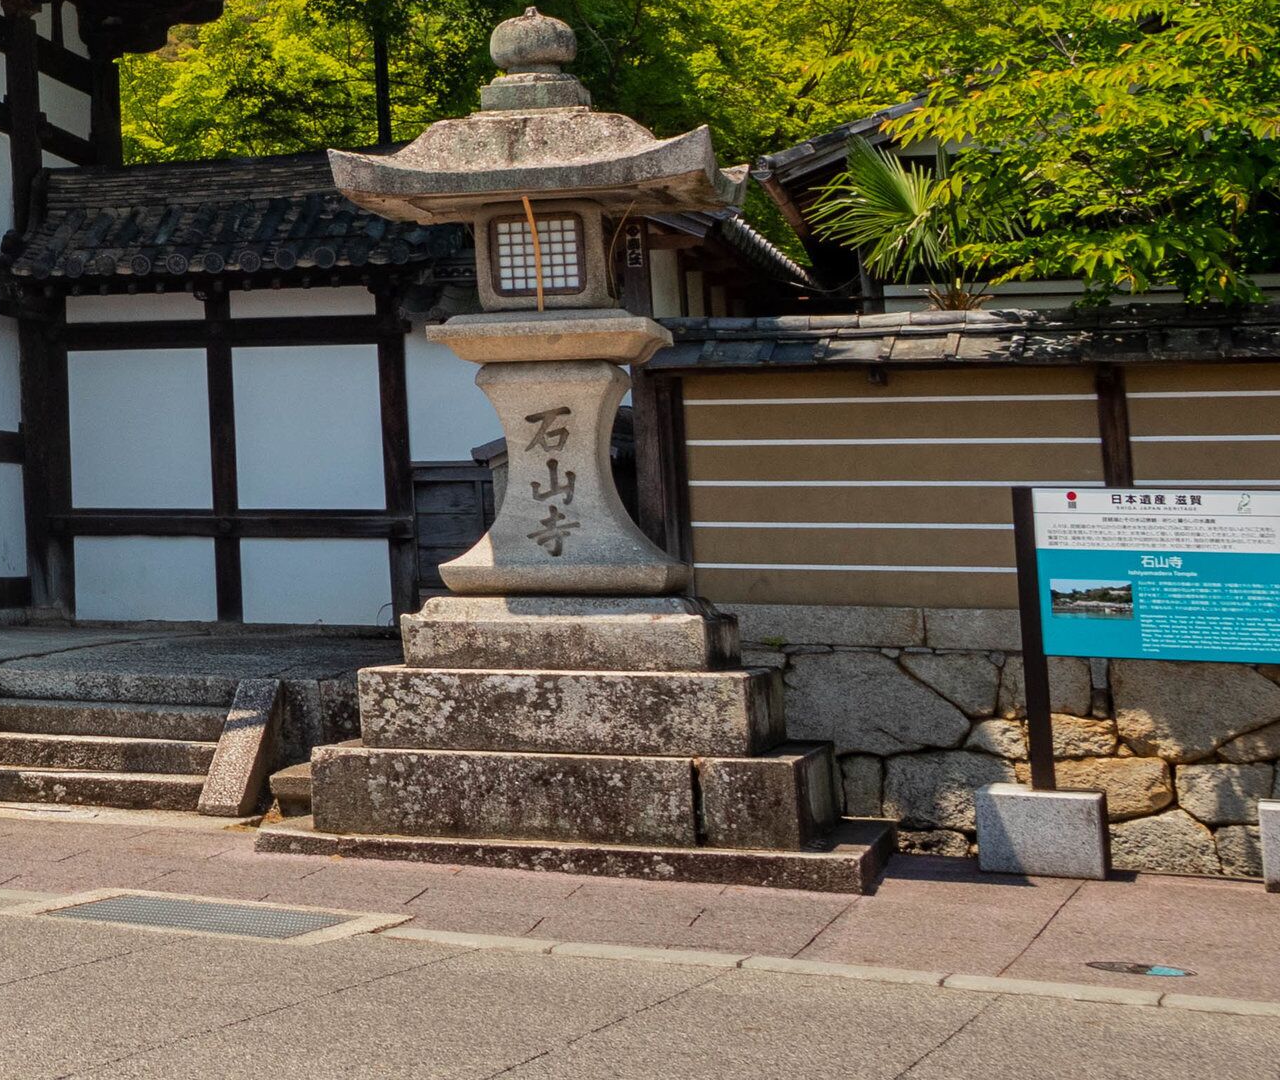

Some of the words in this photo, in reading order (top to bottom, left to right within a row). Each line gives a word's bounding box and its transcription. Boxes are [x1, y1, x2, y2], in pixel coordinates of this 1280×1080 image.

[524, 406, 581, 557] 石山寺
[1111, 494, 1166, 505] 日本遺産
[1175, 495, 1202, 505] 滋賀
[1141, 555, 1183, 568] 石山寺
